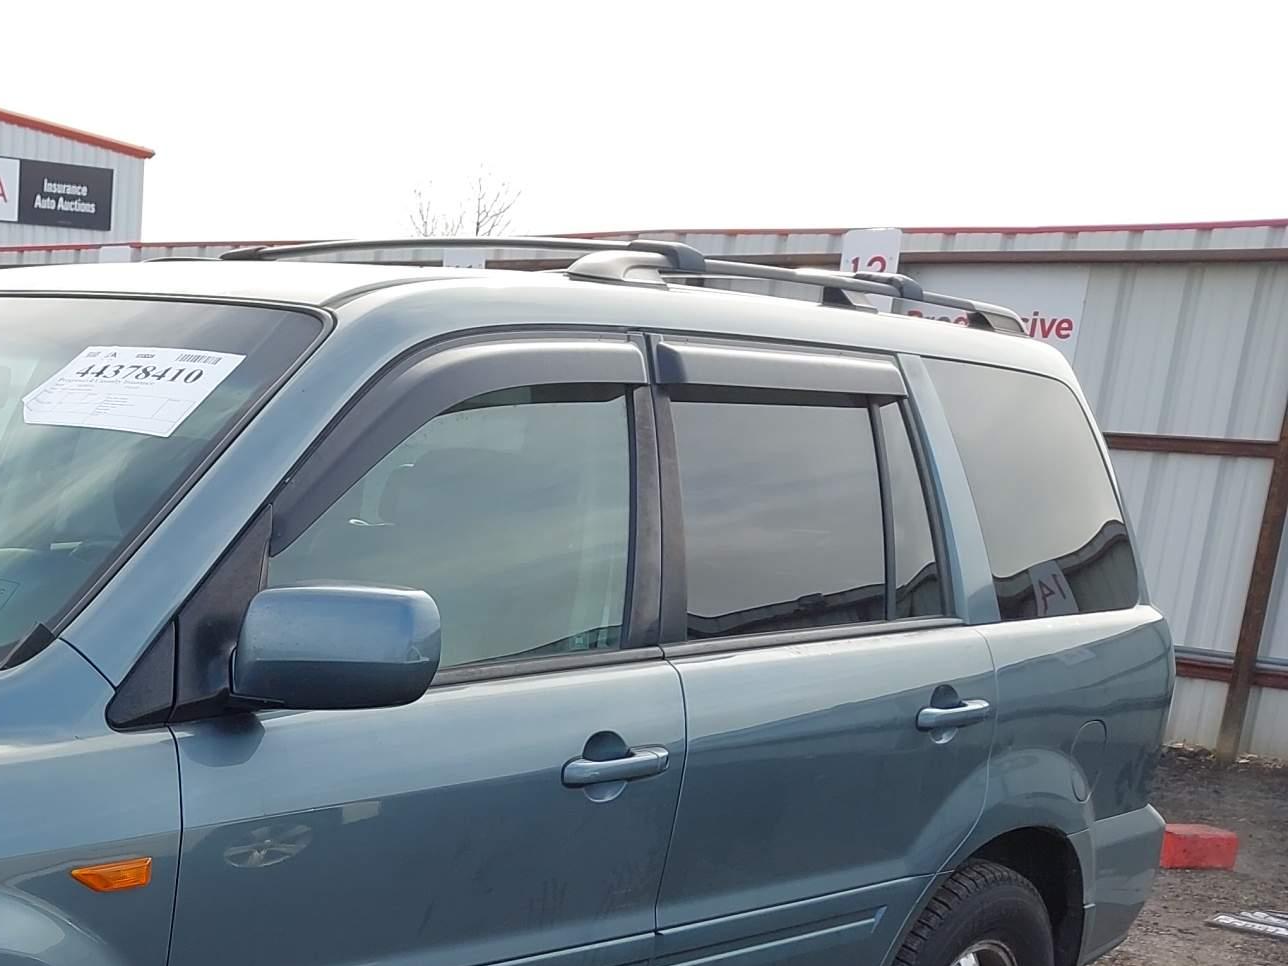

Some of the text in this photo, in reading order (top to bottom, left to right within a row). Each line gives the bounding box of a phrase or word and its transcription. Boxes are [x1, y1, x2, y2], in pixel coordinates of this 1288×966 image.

[43, 178, 88, 197] Insurance
[34, 194, 96, 214] Auto Auctions
[76, 364, 204, 384] 44378410
